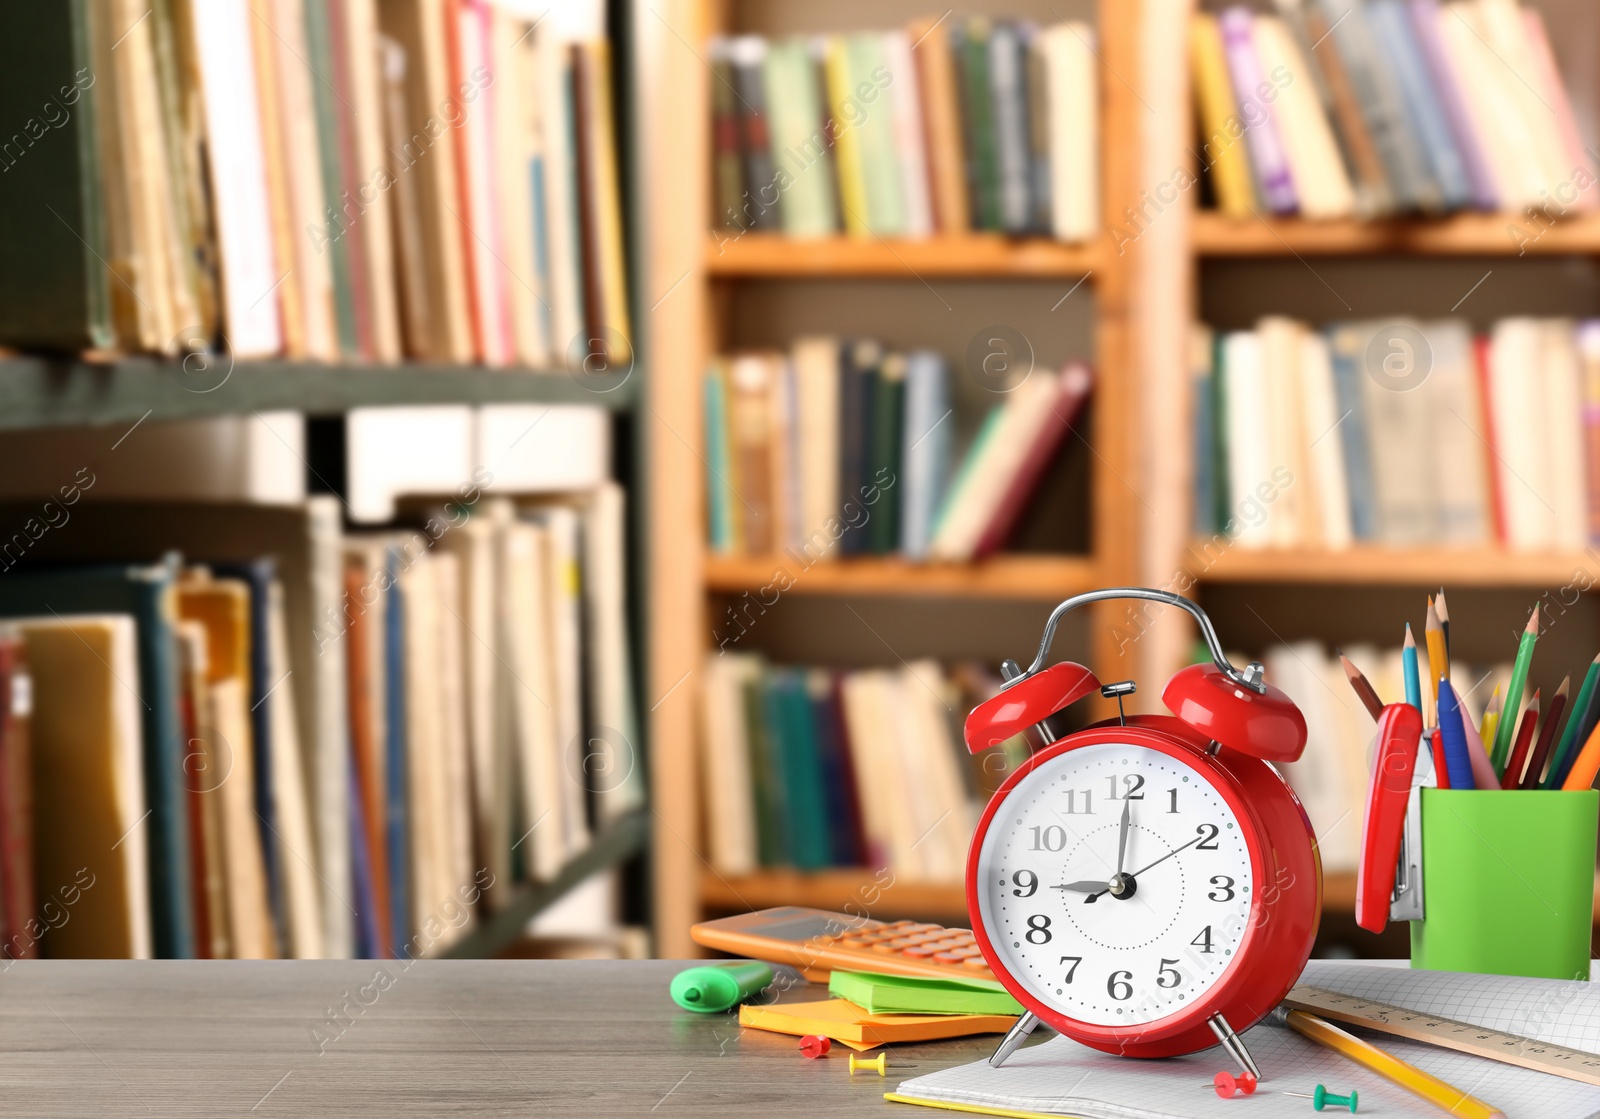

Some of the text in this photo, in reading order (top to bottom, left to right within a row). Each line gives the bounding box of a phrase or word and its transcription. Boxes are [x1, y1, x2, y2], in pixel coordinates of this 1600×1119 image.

[1104, 774, 1145, 800] 12
[1062, 788, 1097, 815] 11
[1166, 788, 1181, 814] 1
[1027, 825, 1067, 852] 10
[1195, 823, 1219, 850] 2
[1012, 869, 1039, 897] 9
[1208, 875, 1235, 902] 3
[1025, 914, 1052, 945] 8
[1190, 925, 1215, 953] 4
[1060, 956, 1083, 985] 7
[1156, 958, 1182, 988] 5
[1107, 970, 1133, 1000] 6
